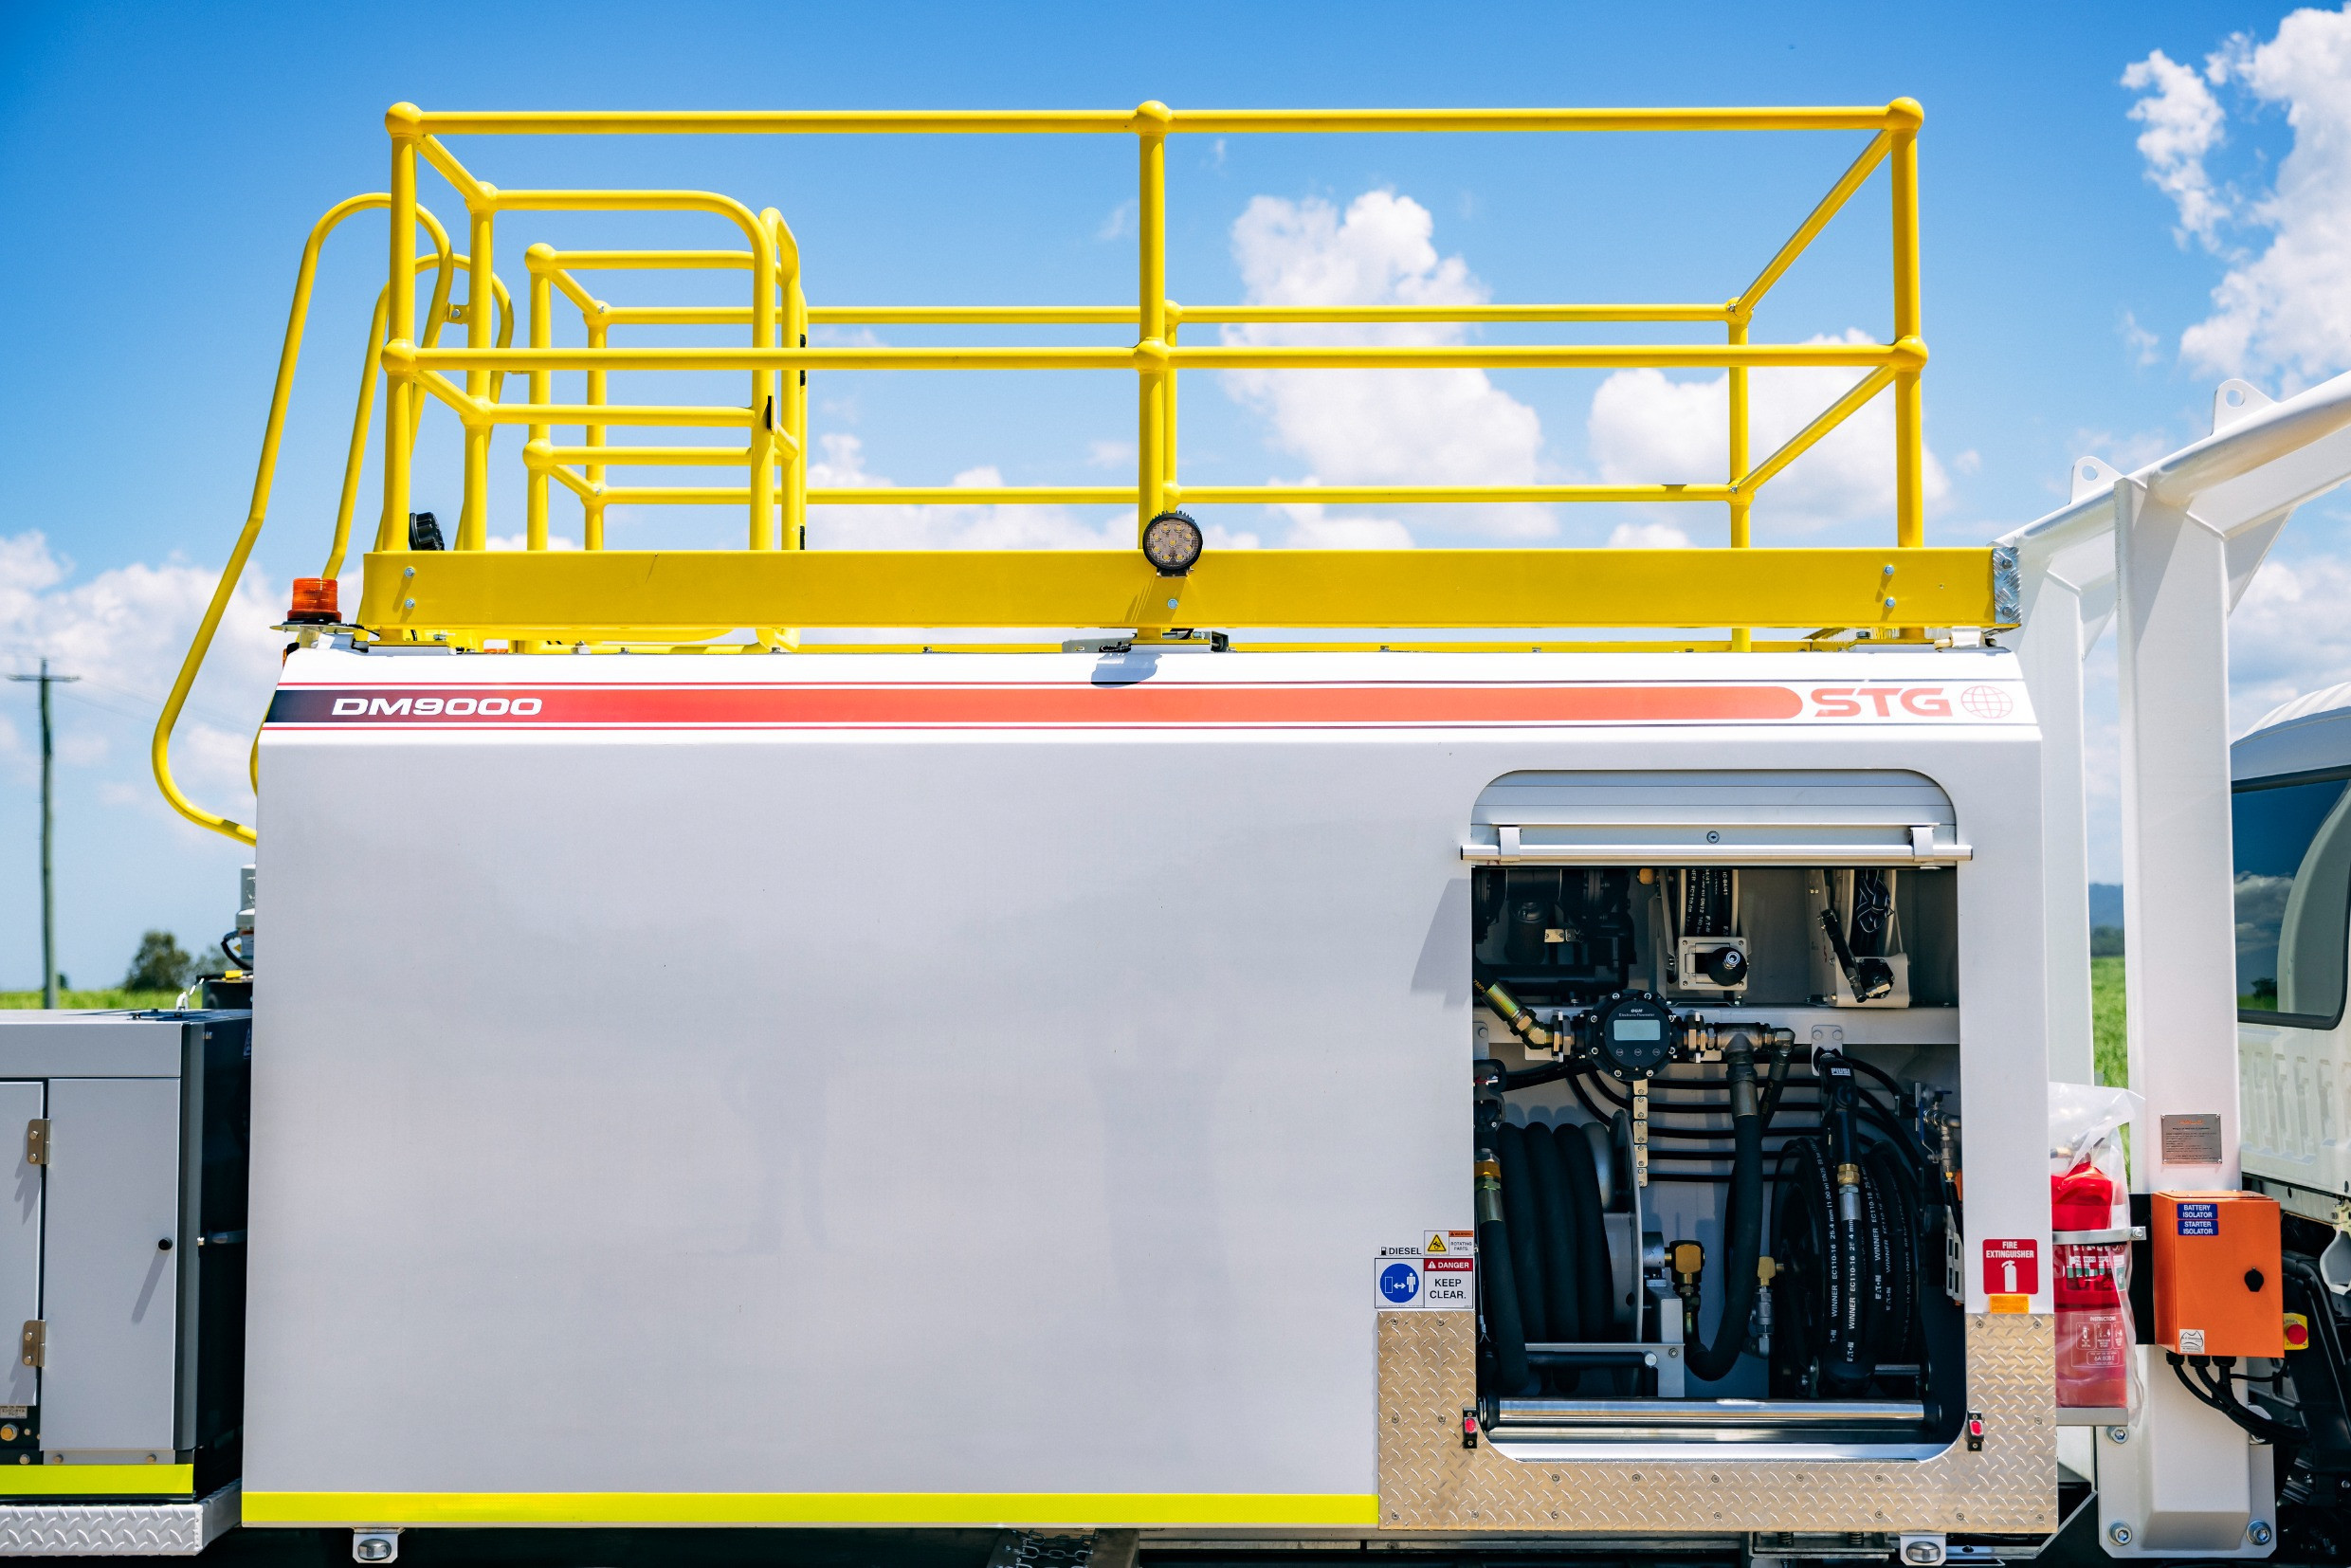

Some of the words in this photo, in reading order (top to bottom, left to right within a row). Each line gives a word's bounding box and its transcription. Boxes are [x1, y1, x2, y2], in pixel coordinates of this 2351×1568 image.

[332, 698, 543, 716] DM9000
[1811, 687, 1953, 717] STG
[1872, 1228, 1881, 1261] WINNER
[1430, 1290, 1467, 1299] CLEAR.
